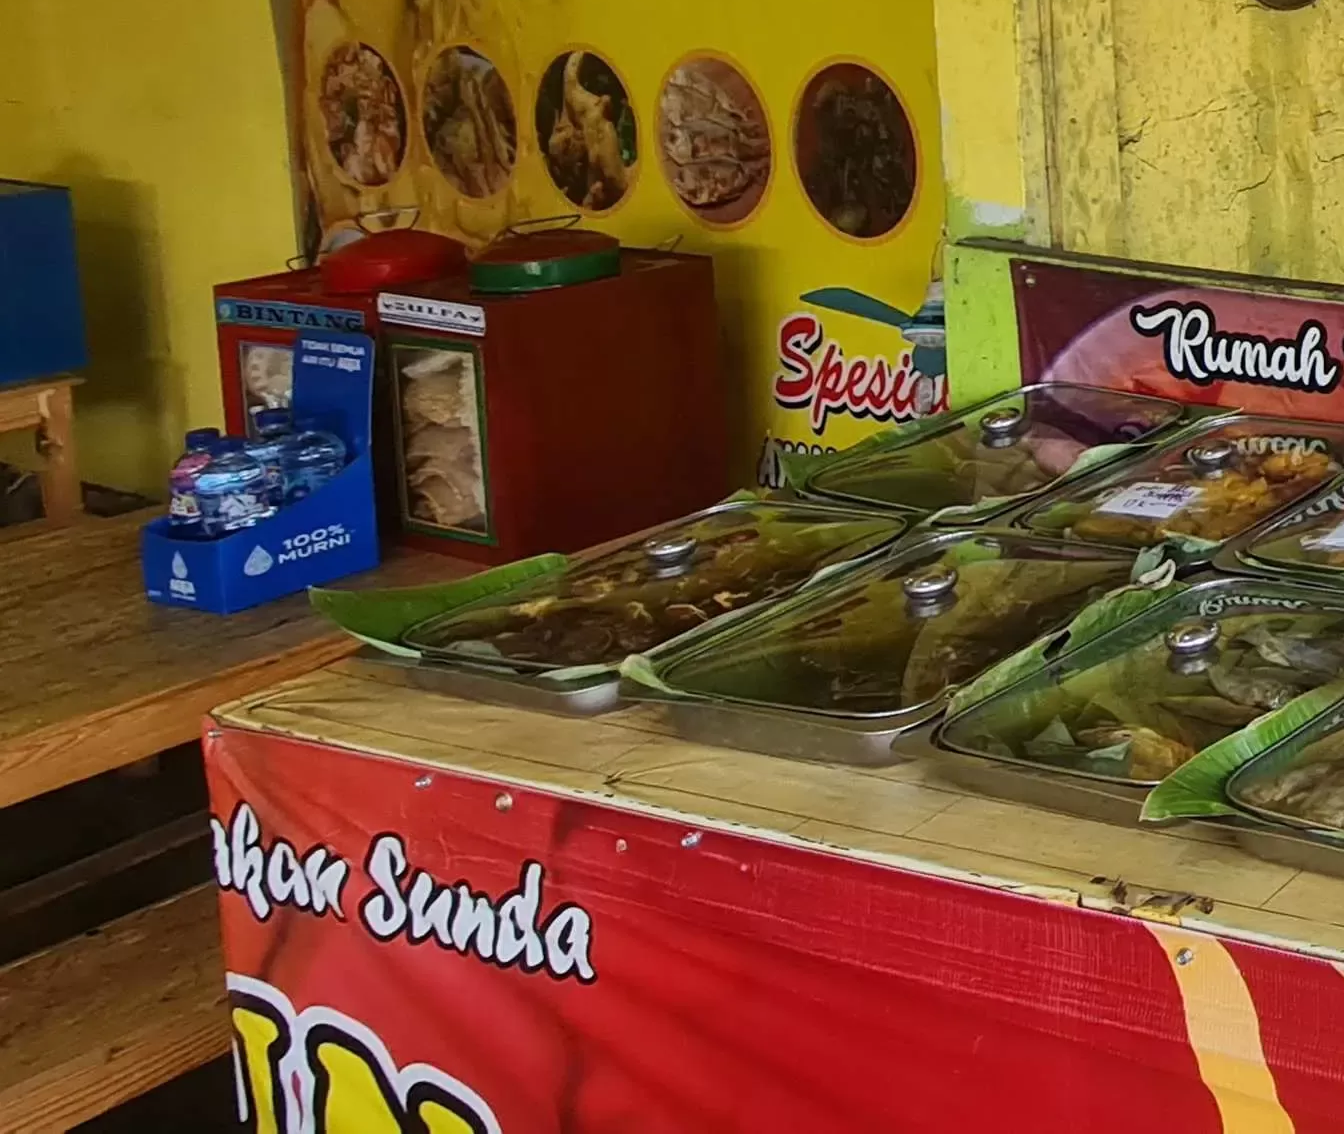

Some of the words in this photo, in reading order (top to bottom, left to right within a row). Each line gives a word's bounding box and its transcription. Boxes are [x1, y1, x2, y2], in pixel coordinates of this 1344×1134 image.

[235, 303, 361, 329] BINTANG
[1131, 300, 1343, 394] Rumah
[278, 533, 351, 564] MURNI
[282, 523, 345, 550] 100%
[360, 830, 598, 984] Sunda
